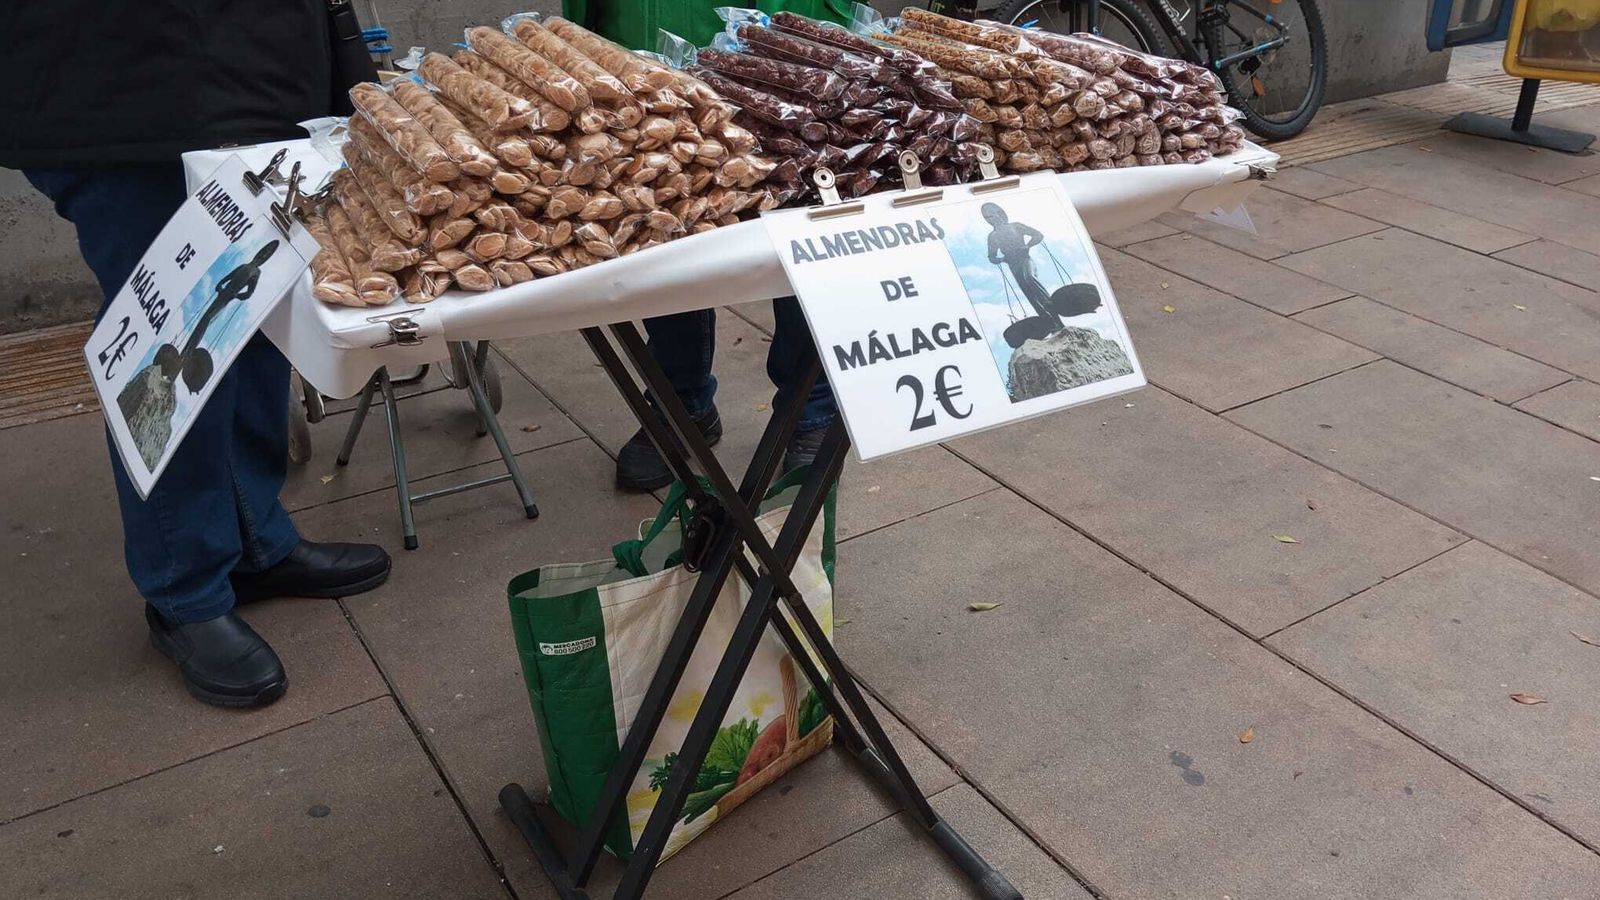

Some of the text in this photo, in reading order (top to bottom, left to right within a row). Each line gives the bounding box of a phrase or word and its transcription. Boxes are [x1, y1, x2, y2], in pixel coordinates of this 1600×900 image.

[196, 179, 253, 244] ALMENDRAS
[789, 217, 945, 264] ALMENDRAS
[175, 242, 196, 270] DE
[130, 264, 171, 336] MÁLAGA
[880, 276, 919, 301] DE
[98, 316, 139, 381] 2€
[832, 317, 982, 371] MÁLAGA
[895, 365, 974, 432] 2€
